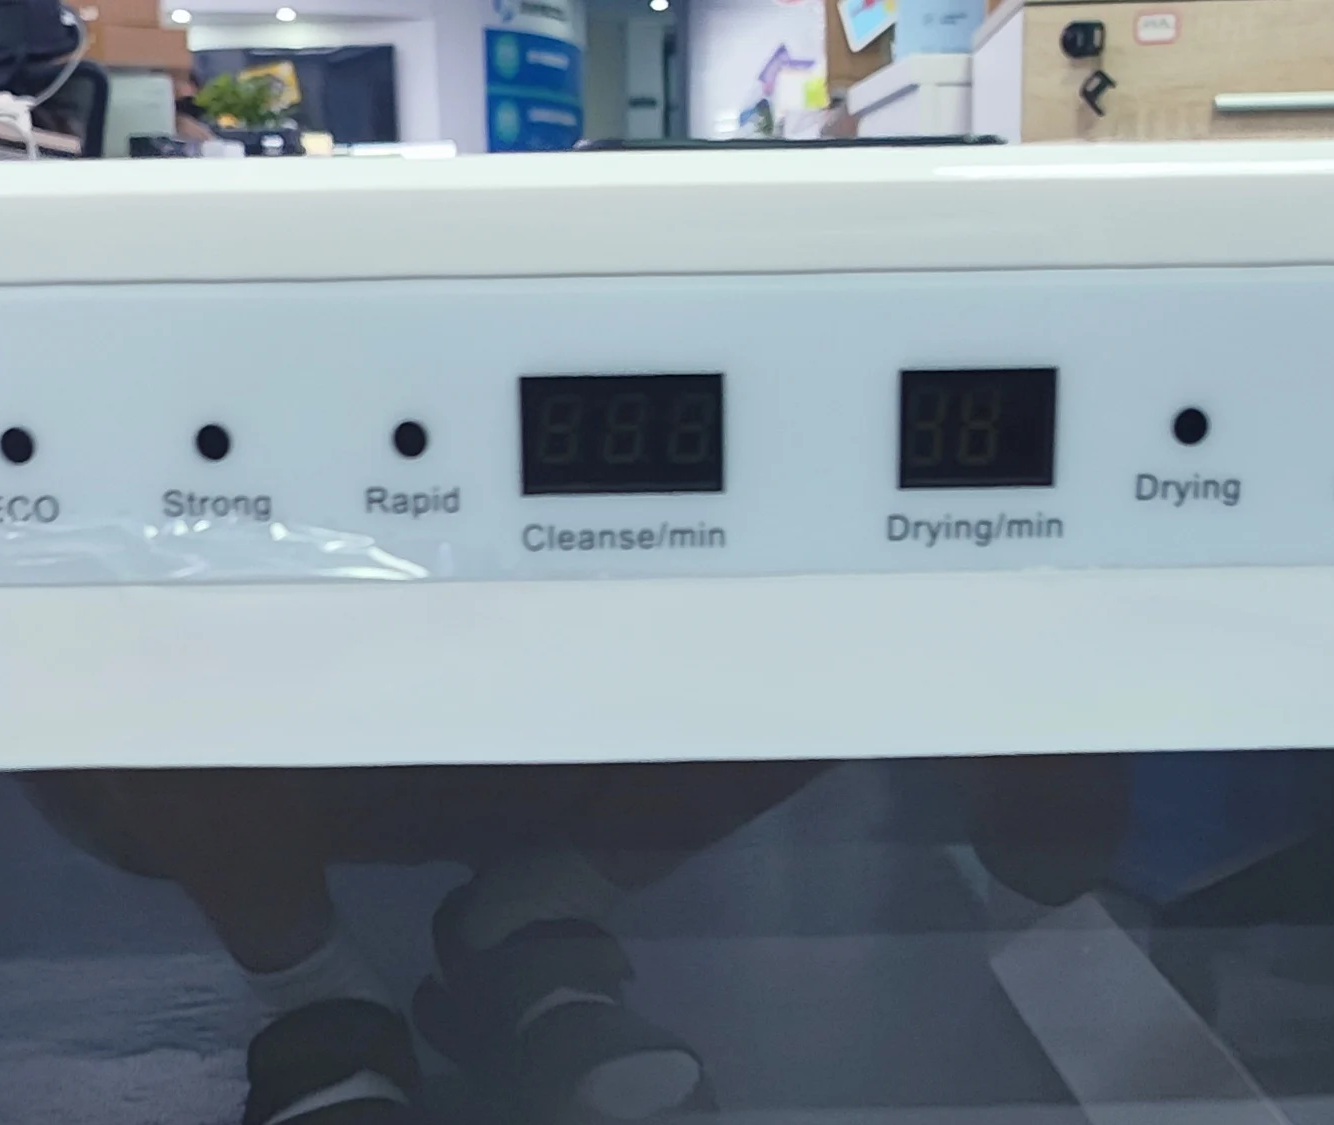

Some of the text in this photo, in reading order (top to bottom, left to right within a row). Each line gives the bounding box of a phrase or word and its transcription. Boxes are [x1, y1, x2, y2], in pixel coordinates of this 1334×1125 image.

[161, 487, 273, 524] Strong
[364, 484, 462, 520] Rapid
[1134, 471, 1242, 507] Drying
[521, 520, 727, 554] Cleanse/min
[885, 510, 1065, 549] Drying/min
